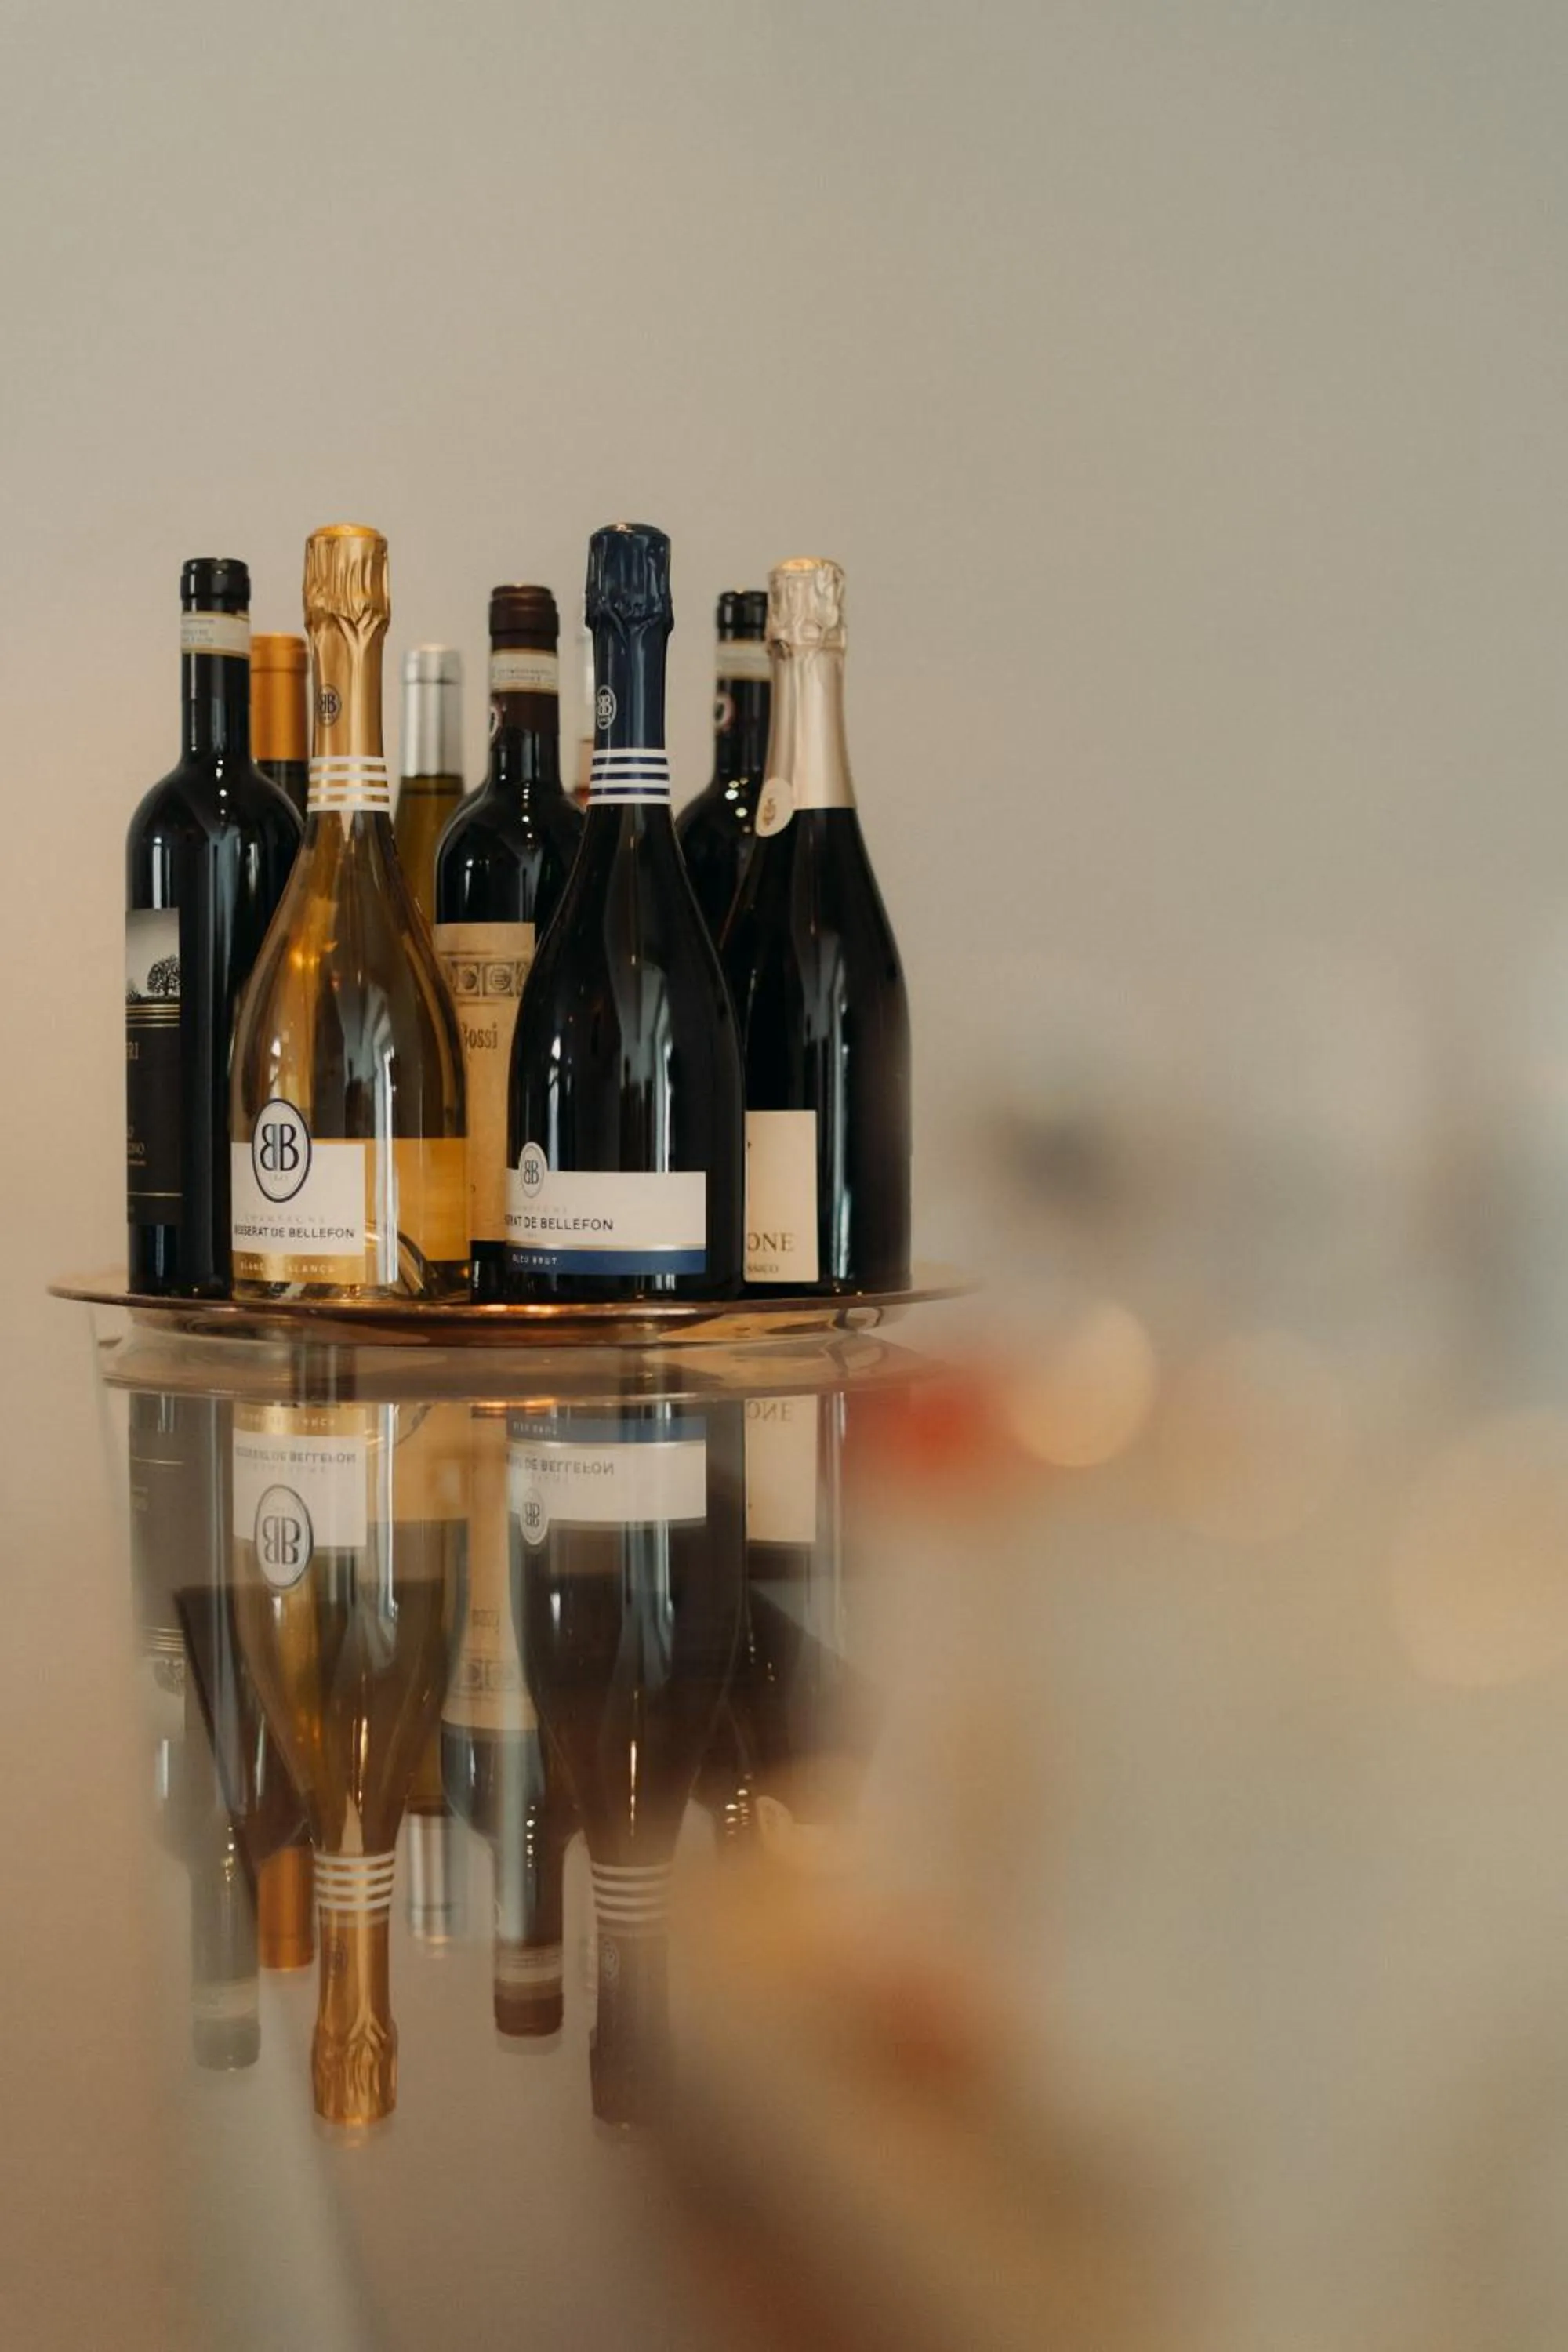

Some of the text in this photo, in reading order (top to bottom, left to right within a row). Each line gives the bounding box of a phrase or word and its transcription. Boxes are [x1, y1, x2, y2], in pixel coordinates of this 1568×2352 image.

[505, 1214, 614, 1231] RAT DE BELLEFON
[271, 1226, 285, 1238] DE
[289, 1227, 356, 1239] BELLEFON
[747, 1232, 795, 1253] ONE
